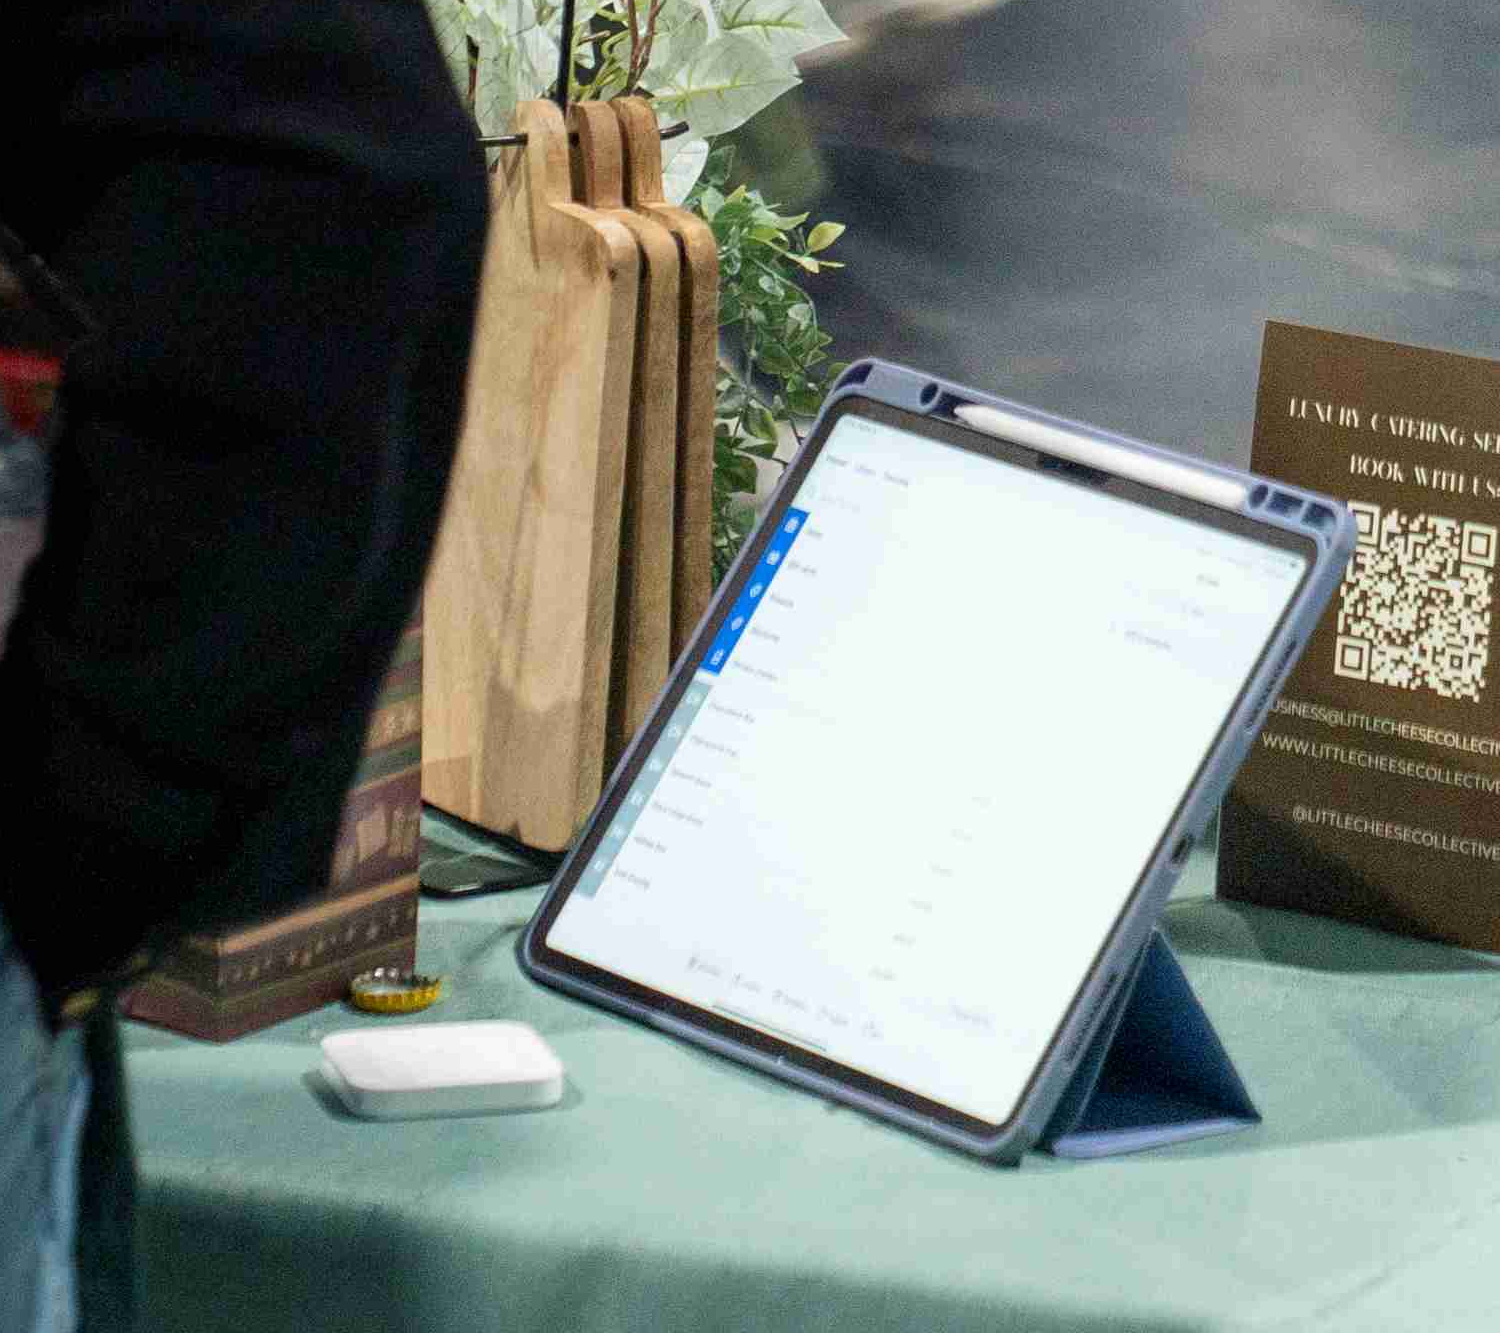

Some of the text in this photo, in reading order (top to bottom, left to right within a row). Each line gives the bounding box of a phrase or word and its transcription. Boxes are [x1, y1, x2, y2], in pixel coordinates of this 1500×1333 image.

[1288, 397, 1360, 429] LUXURY
[1371, 413, 1465, 447] CATERING
[1350, 453, 1404, 483] BOOK
[1414, 466, 1465, 494] WITH
[1292, 805, 1500, 861] @LITTLECHEESECOLLECTIVE
